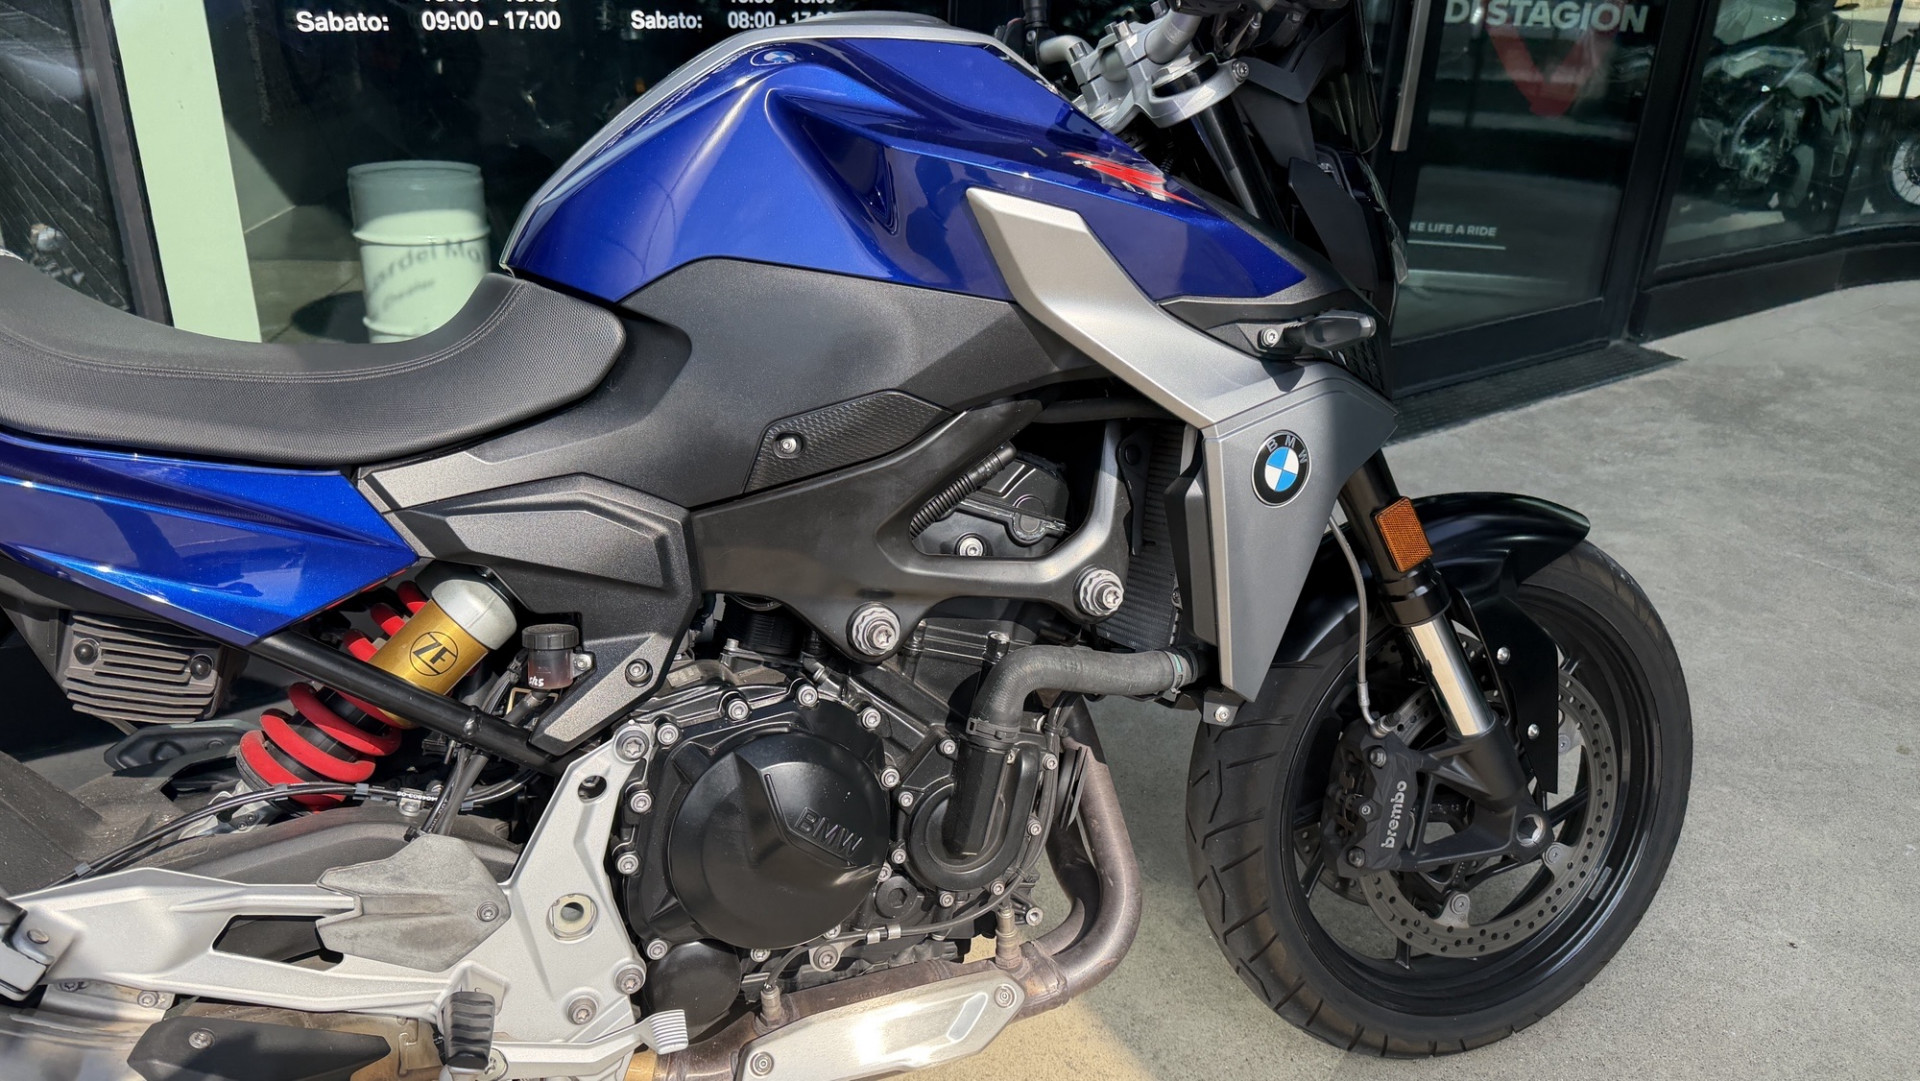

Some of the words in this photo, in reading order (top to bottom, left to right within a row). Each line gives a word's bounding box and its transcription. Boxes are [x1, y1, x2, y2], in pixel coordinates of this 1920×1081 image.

[296, 11, 390, 32] Sabato:
[421, 10, 484, 31] 09:00
[504, 10, 561, 30] 17:00
[631, 10, 703, 30] Sabato:
[728, 11, 776, 29] 08:00
[1409, 222, 1426, 232] KE
[1428, 223, 1454, 234] LIFE
[1455, 225, 1466, 235] A
[1467, 225, 1498, 237] RIDE
[1265, 434, 1308, 464] BMW
[411, 632, 458, 675] ZF
[1380, 780, 1407, 848] brembo
[794, 806, 863, 858] BMW
